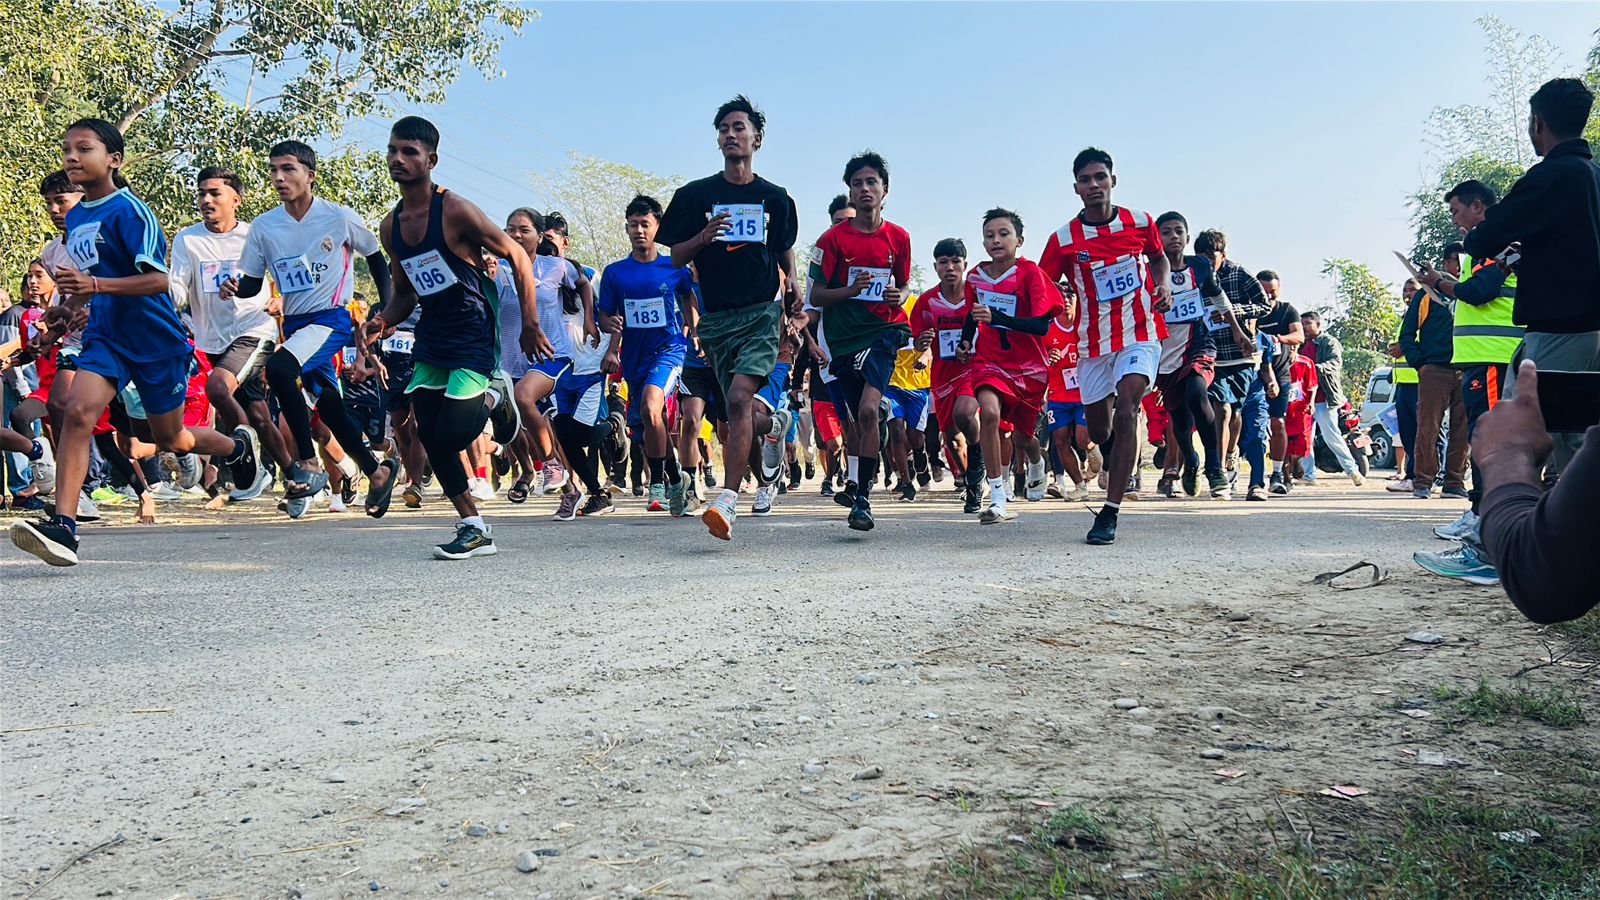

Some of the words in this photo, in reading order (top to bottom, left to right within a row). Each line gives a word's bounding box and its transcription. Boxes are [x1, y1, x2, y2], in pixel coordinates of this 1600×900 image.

[73, 239, 95, 263] 112
[285, 269, 313, 287] 110
[415, 267, 446, 291] 196
[1105, 272, 1134, 294] 156
[632, 309, 660, 324] 183
[1171, 301, 1197, 318] 135
[389, 338, 410, 351] 161
